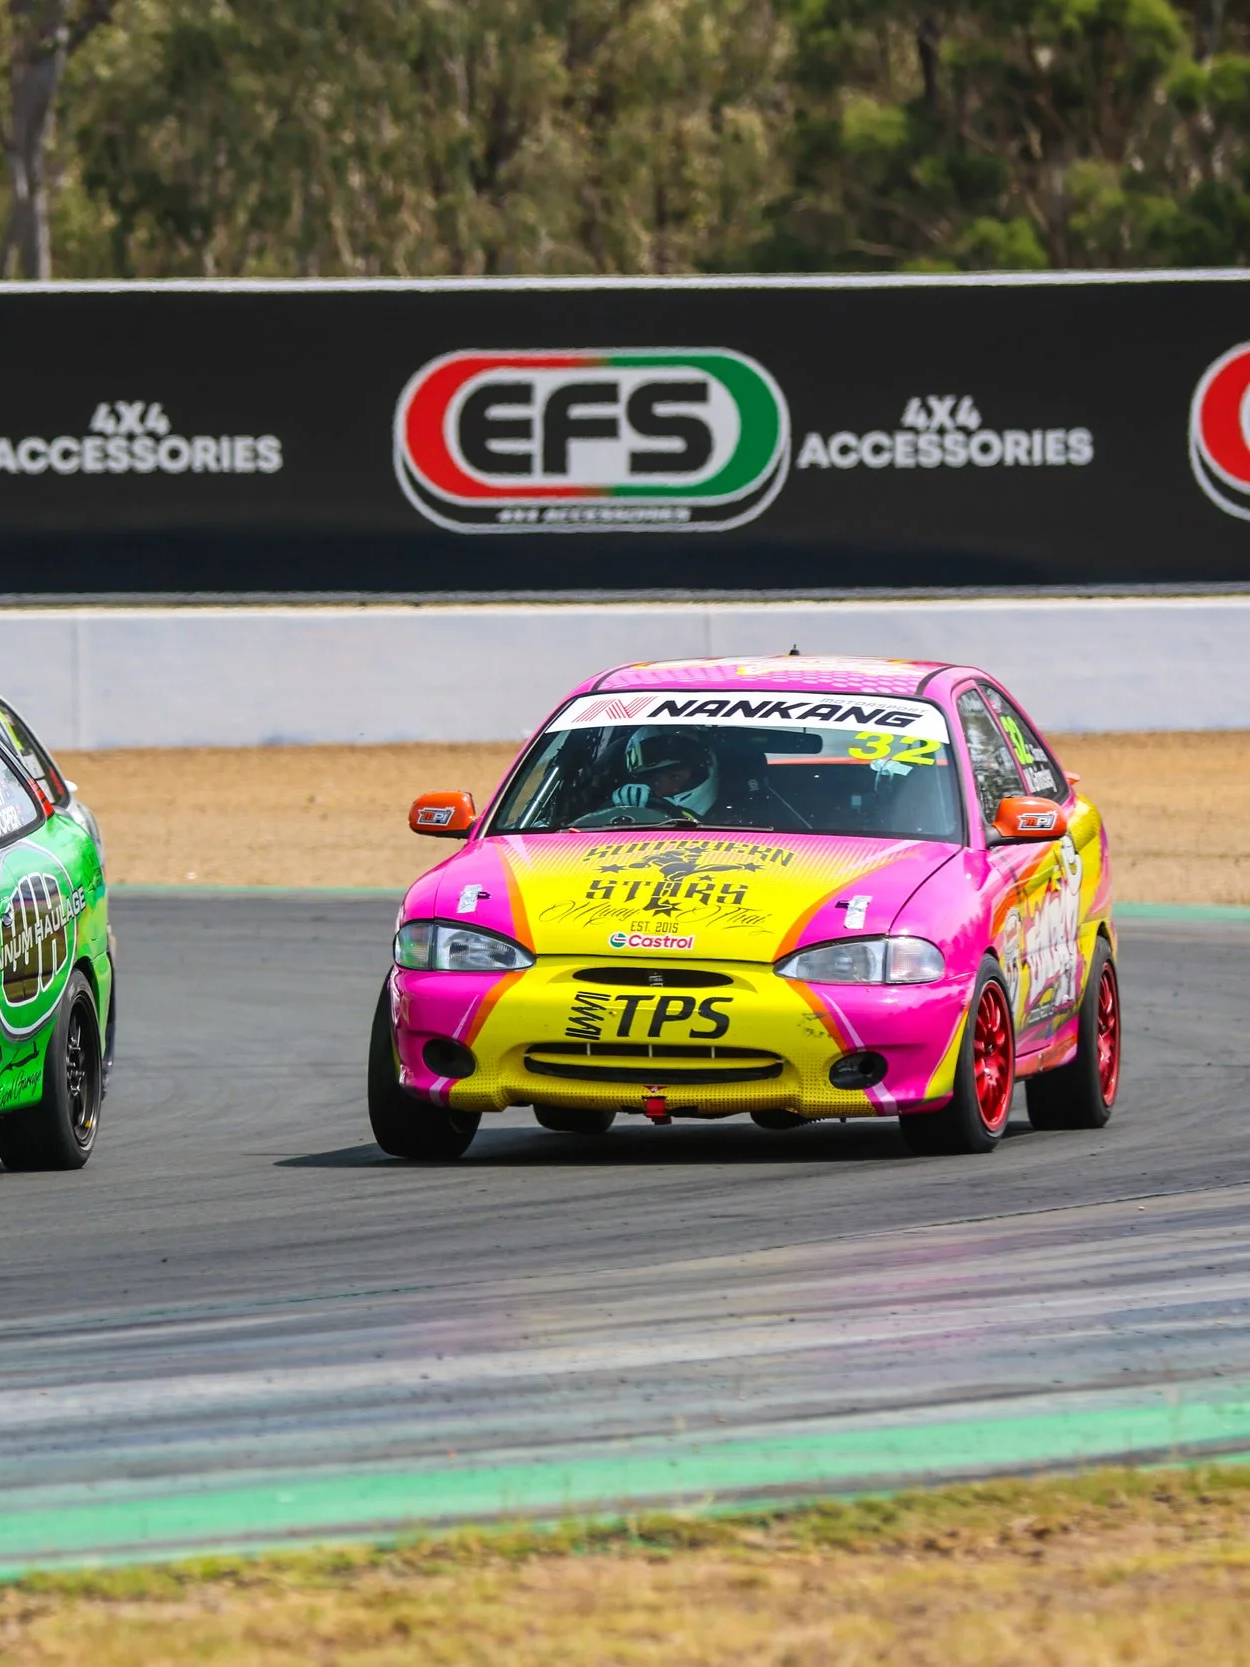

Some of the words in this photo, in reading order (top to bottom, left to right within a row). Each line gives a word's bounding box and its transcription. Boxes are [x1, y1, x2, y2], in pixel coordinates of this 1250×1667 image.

[89, 400, 172, 436] 4X4
[459, 380, 714, 475] EFS
[901, 395, 983, 431] 4X4
[796, 427, 1095, 469] ACCESSORIES
[647, 698, 923, 729] NANKANG
[821, 697, 930, 714] MOTORSPORT
[847, 731, 943, 766] 32
[35, 886, 86, 942] HAULAGE
[655, 920, 679, 934] 2015
[628, 933, 694, 949] Castrol
[614, 994, 734, 1040] TPS
